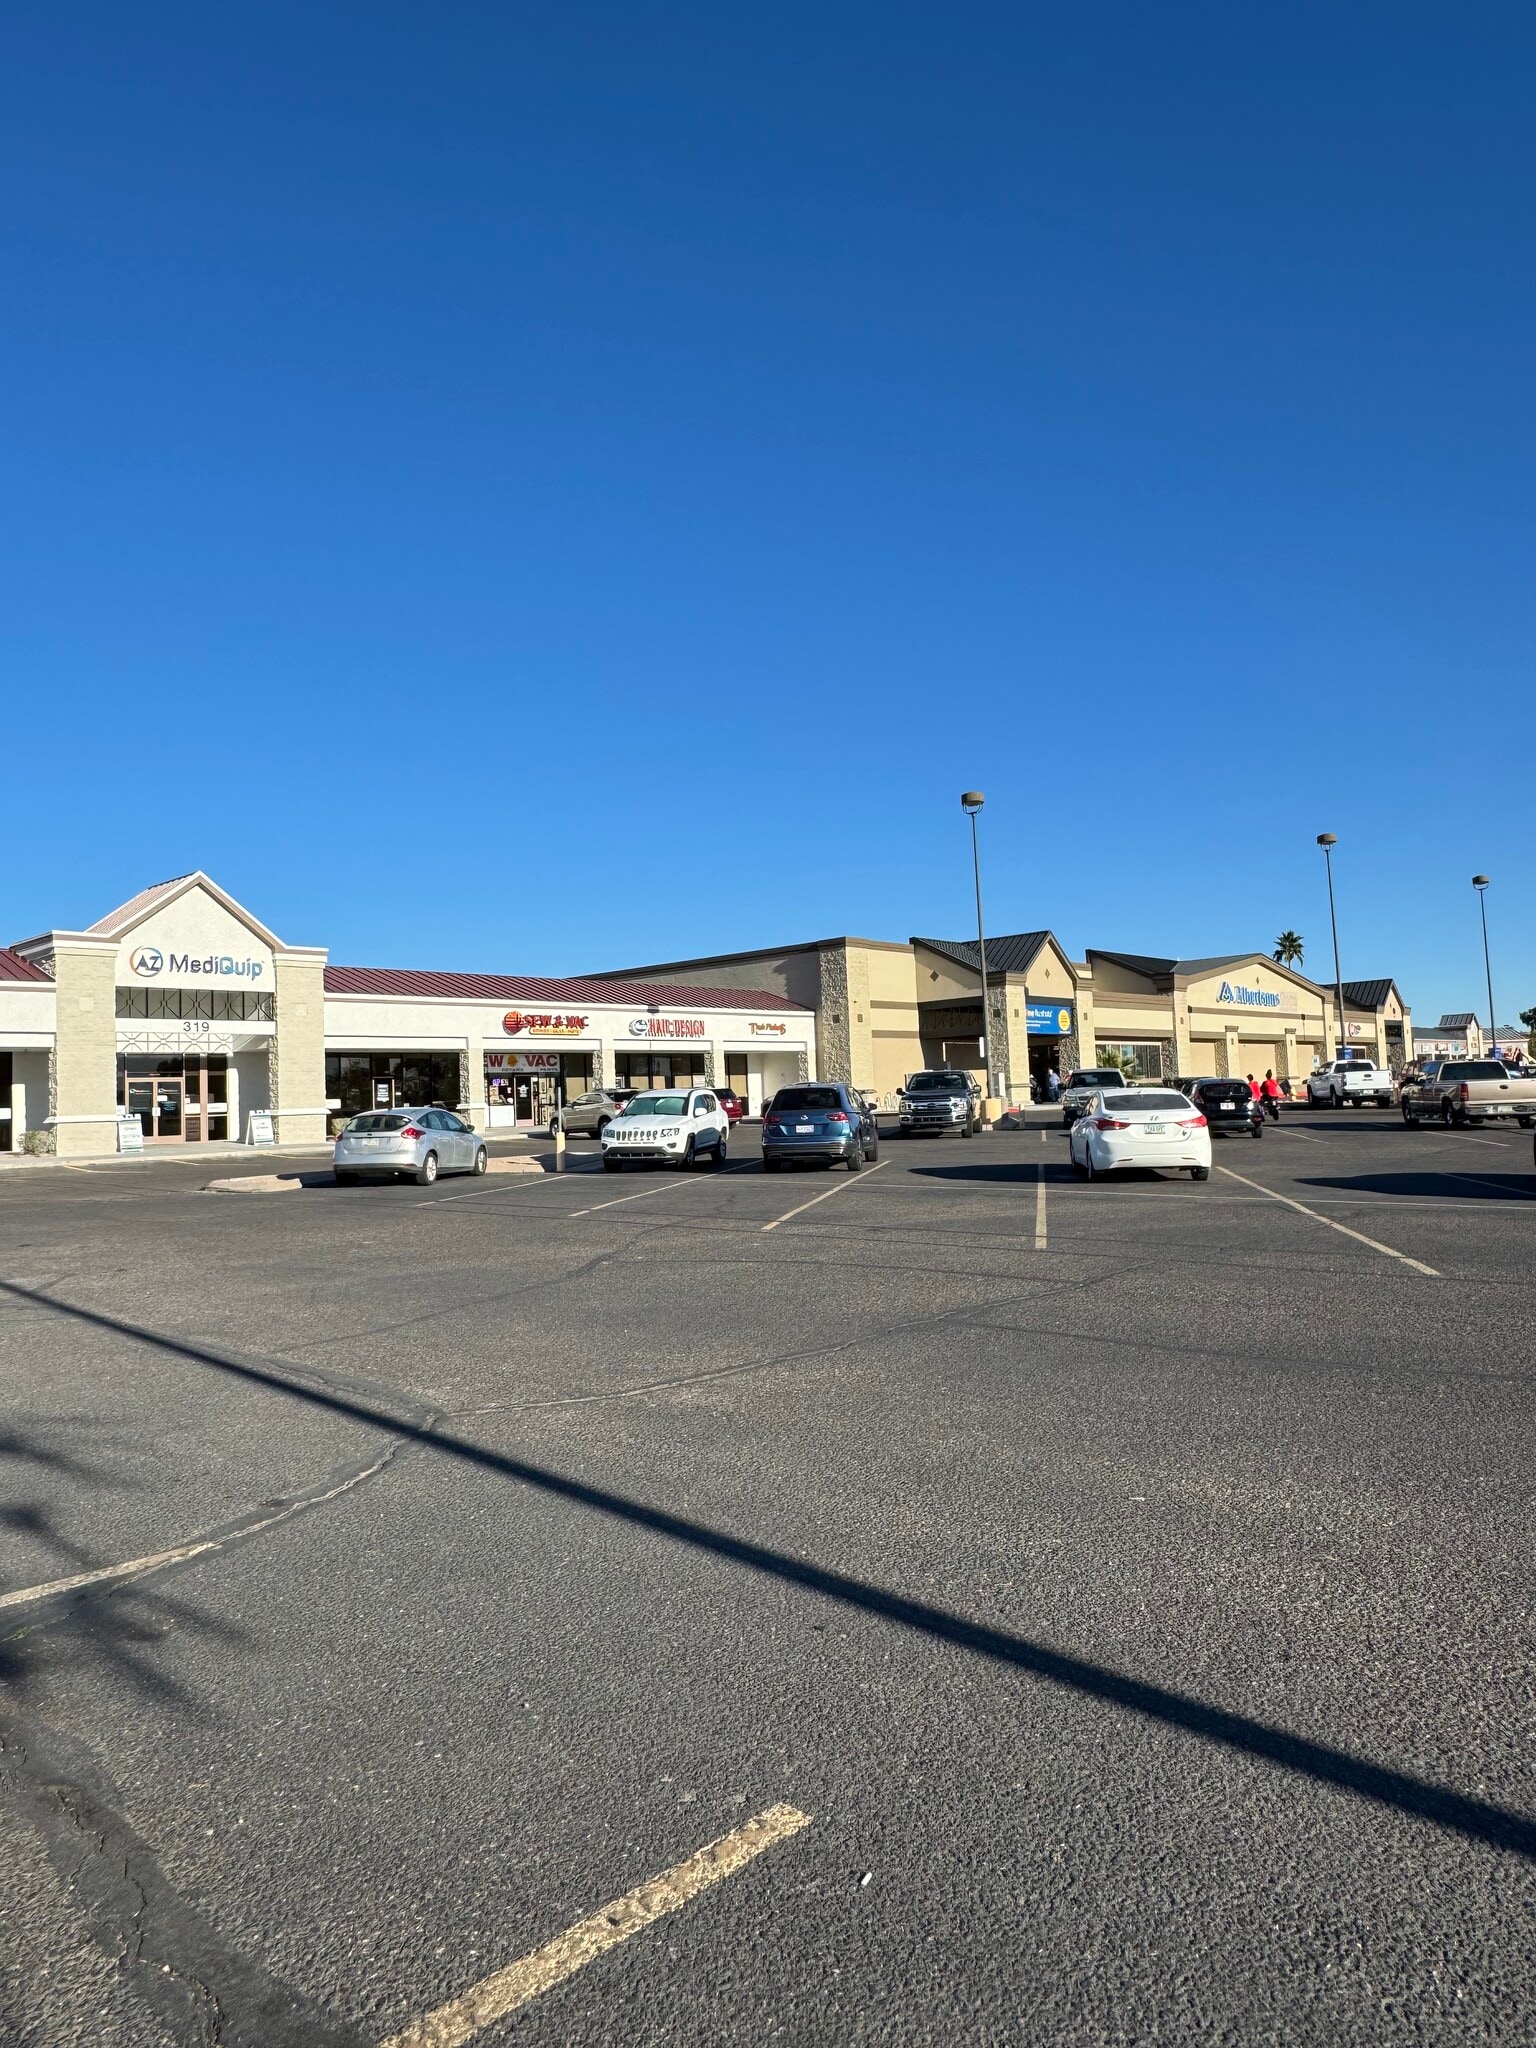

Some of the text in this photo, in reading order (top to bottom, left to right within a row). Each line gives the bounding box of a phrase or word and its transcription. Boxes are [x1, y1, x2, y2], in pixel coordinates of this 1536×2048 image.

[135, 953, 263, 981] AZ MediQuip
[183, 1021, 210, 1032] 319
[672, 1019, 705, 1036] DESIGN
[524, 1054, 558, 1068] VAC
